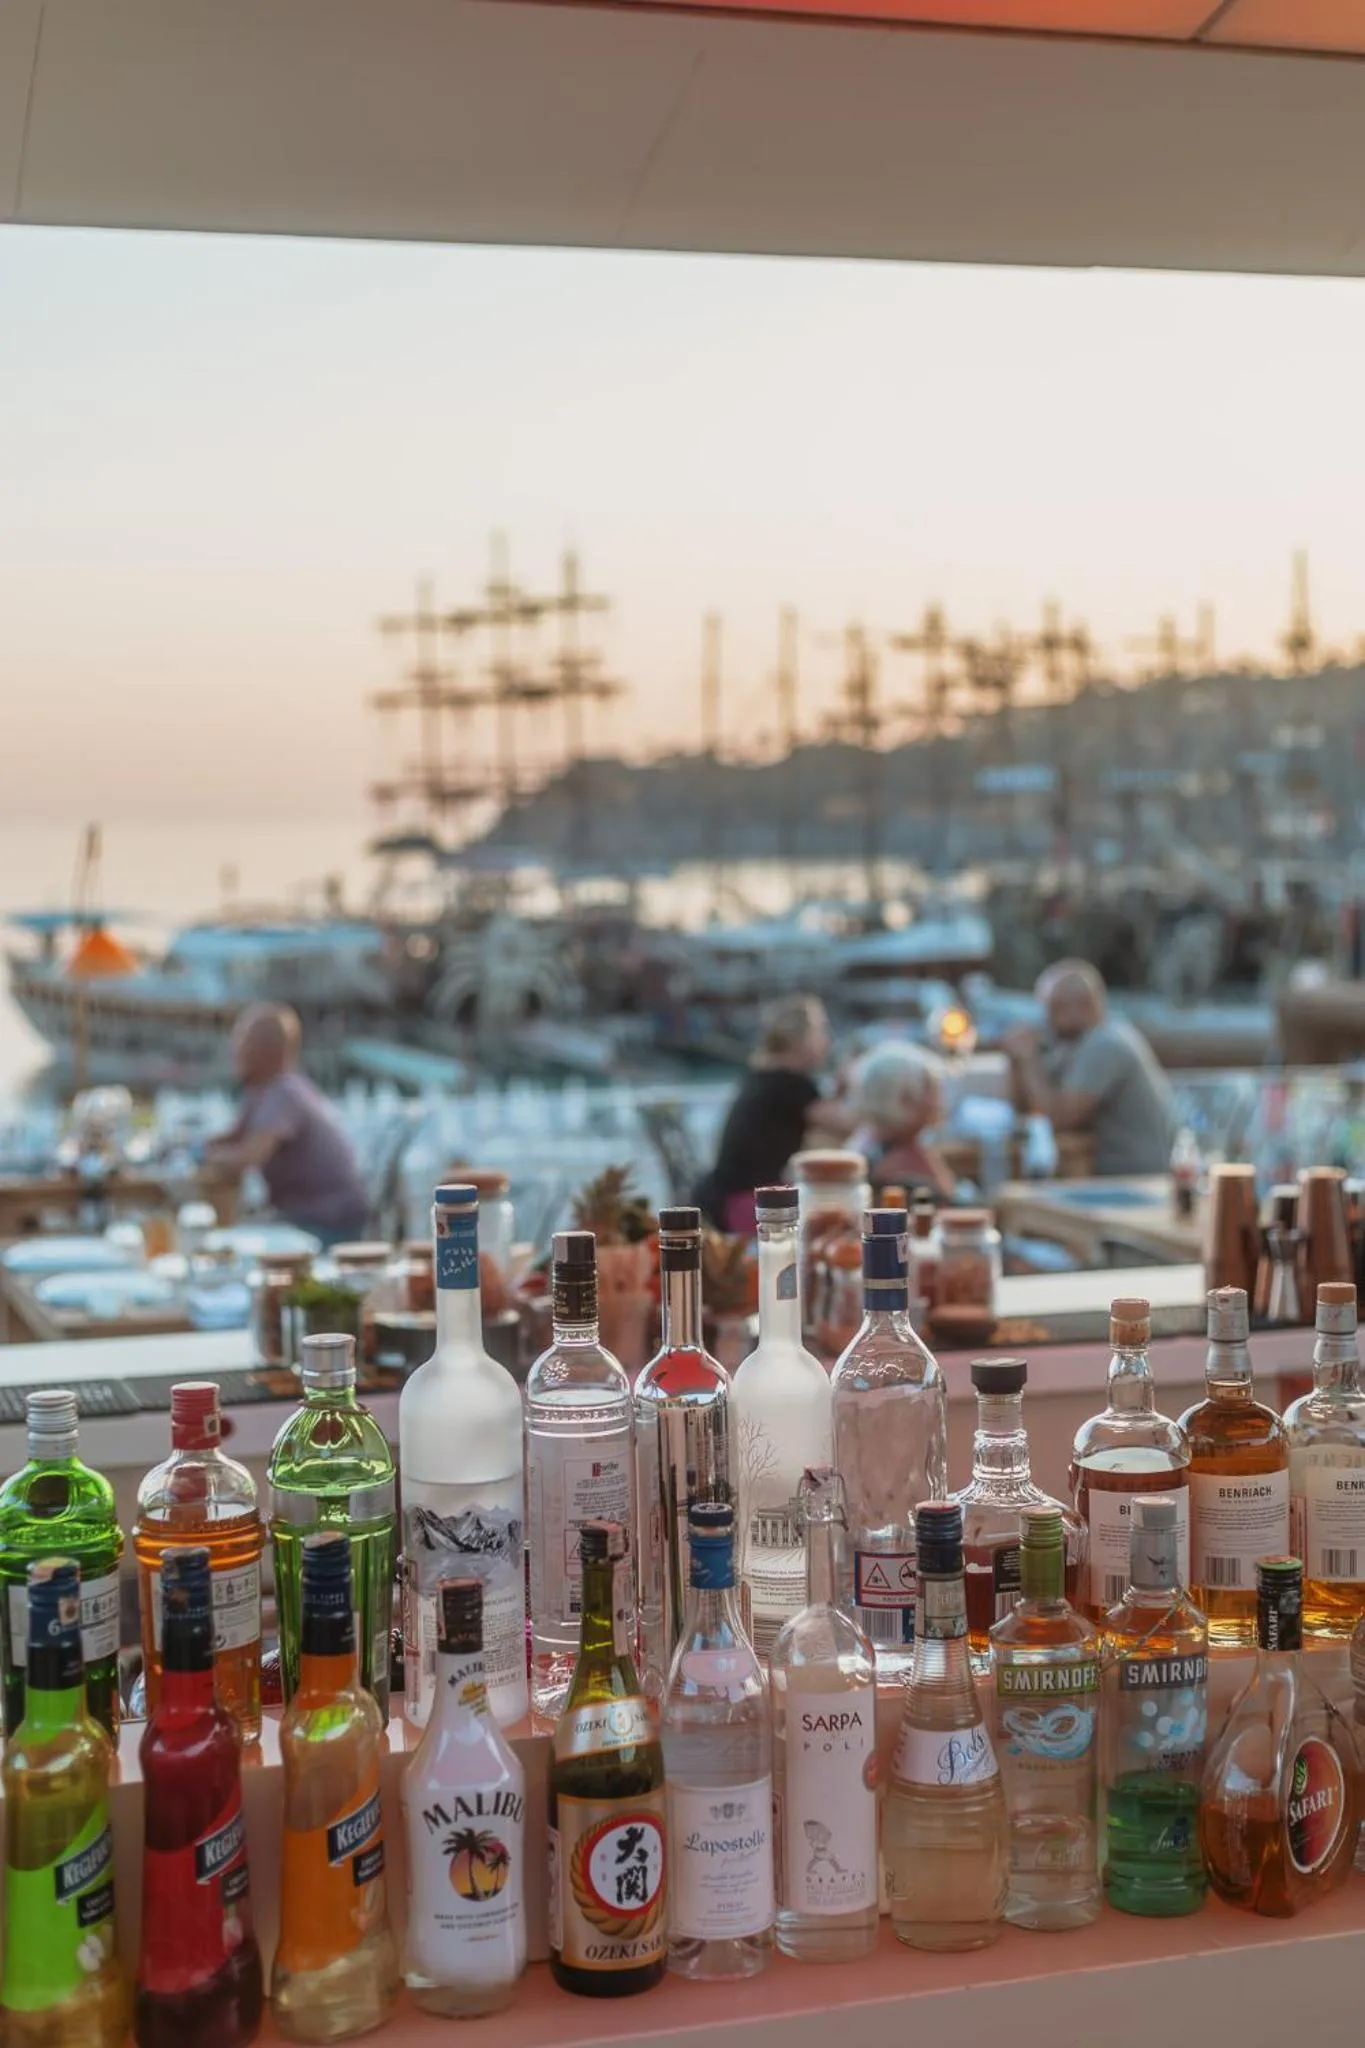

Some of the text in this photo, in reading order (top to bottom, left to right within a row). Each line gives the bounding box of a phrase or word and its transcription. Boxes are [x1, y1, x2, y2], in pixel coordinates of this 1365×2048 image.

[1218, 1486, 1272, 1499] BENRIACH
[1267, 1609, 1279, 1651] SAFARI
[1003, 1667, 1097, 1691] SMIRNOFF
[575, 1718, 607, 1735] OZEKI
[802, 1711, 863, 1732] SARPA
[803, 1737, 865, 1752] POLI
[422, 1791, 525, 1835] MALIBU
[1290, 1786, 1334, 1827] SAFARI
[585, 1943, 638, 1961] OZEKI
